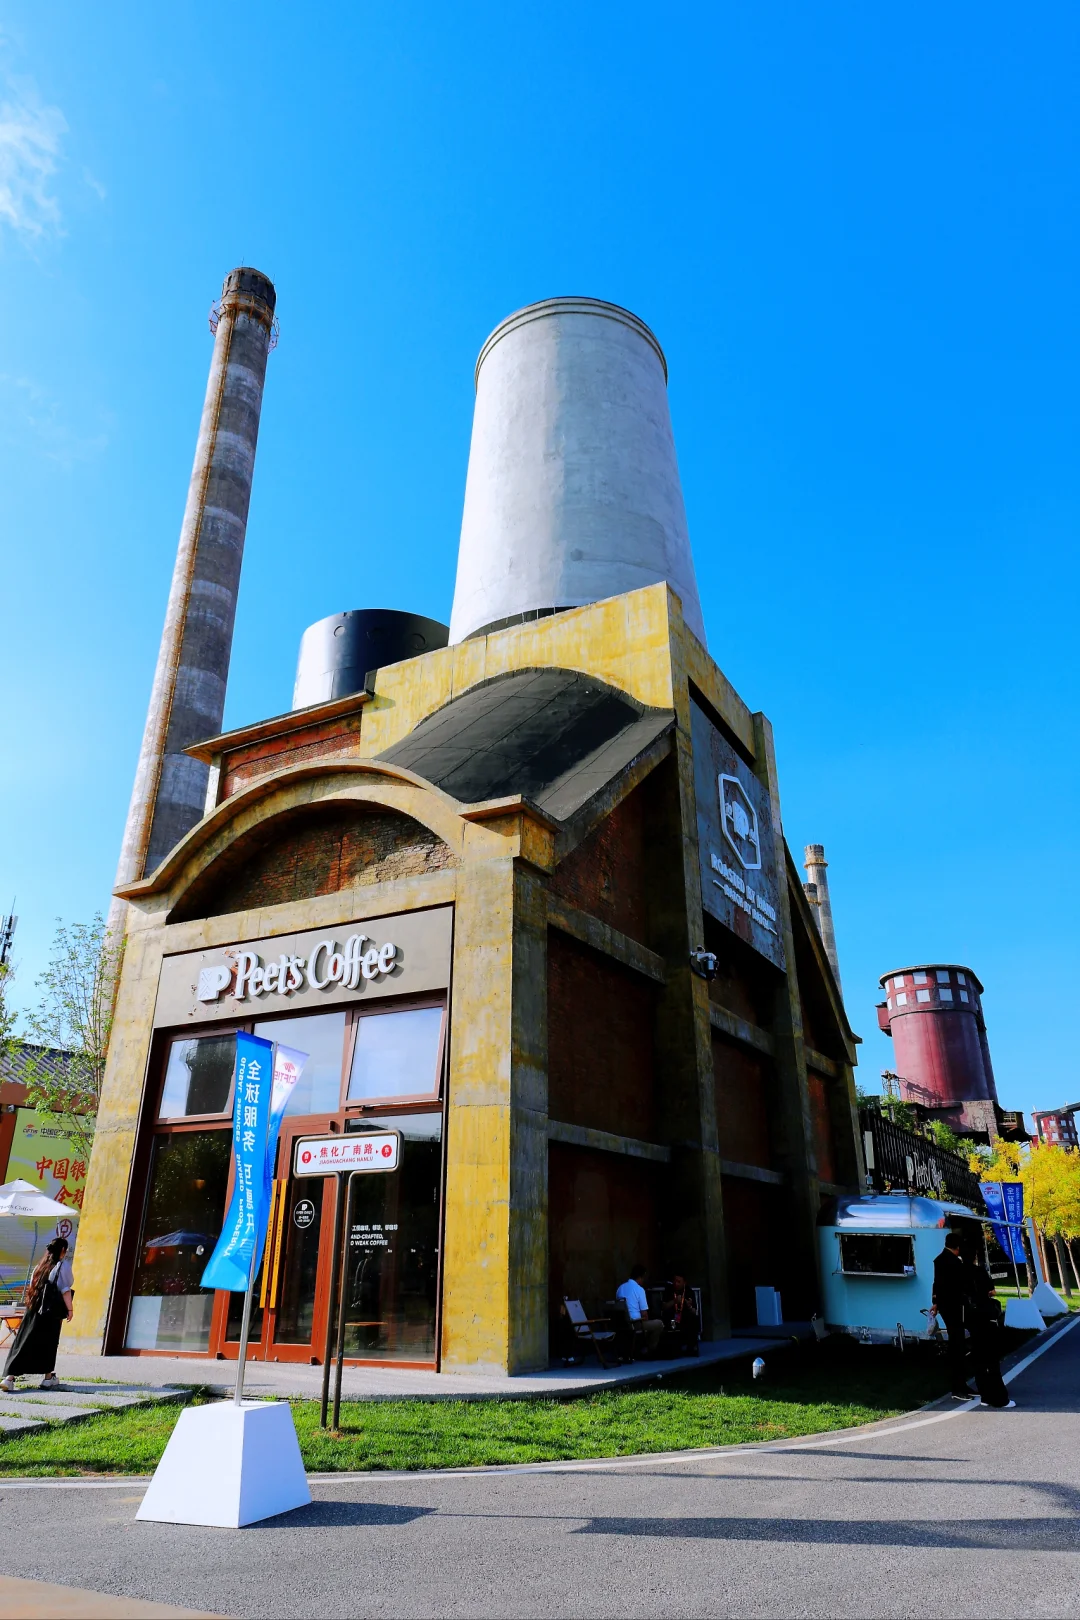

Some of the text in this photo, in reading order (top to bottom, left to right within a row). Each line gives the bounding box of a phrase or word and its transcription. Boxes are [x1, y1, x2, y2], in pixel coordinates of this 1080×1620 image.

[711, 853, 776, 922] ROASTED BY HAND
[234, 951, 305, 1000] Peet's
[307, 934, 397, 990] Coffee
[319, 1143, 374, 1159] 焦化厂南路
[356, 1155, 374, 1163] NANLU
[36, 1155, 87, 1182] 中国银
